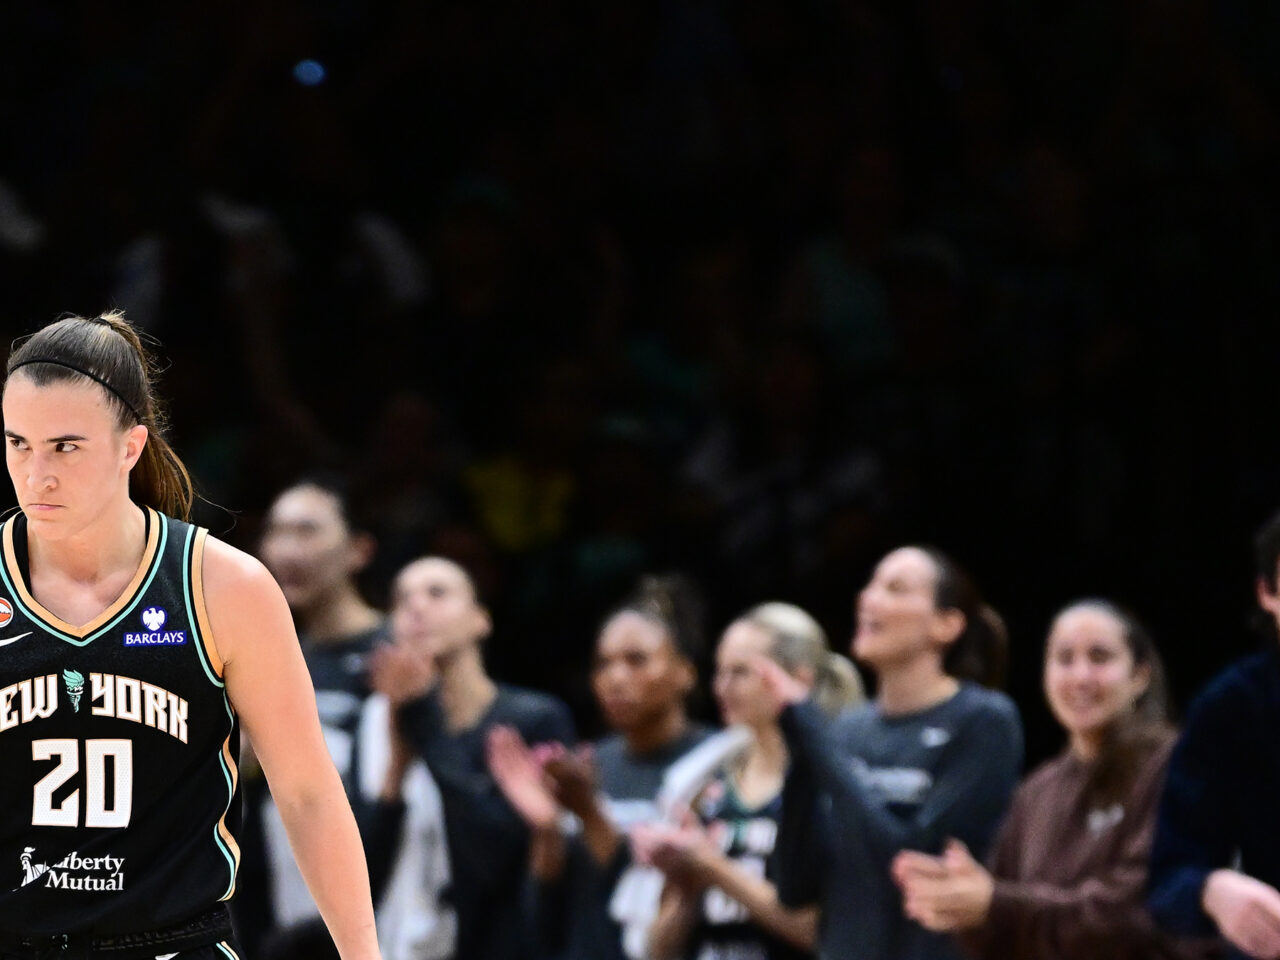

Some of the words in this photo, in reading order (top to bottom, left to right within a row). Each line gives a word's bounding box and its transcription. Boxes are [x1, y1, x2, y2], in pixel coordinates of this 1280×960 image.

[125, 632, 184, 645] BARCLAYS
[89, 672, 189, 744] YORK
[31, 738, 133, 828] 20
[44, 869, 124, 891] Mutual
